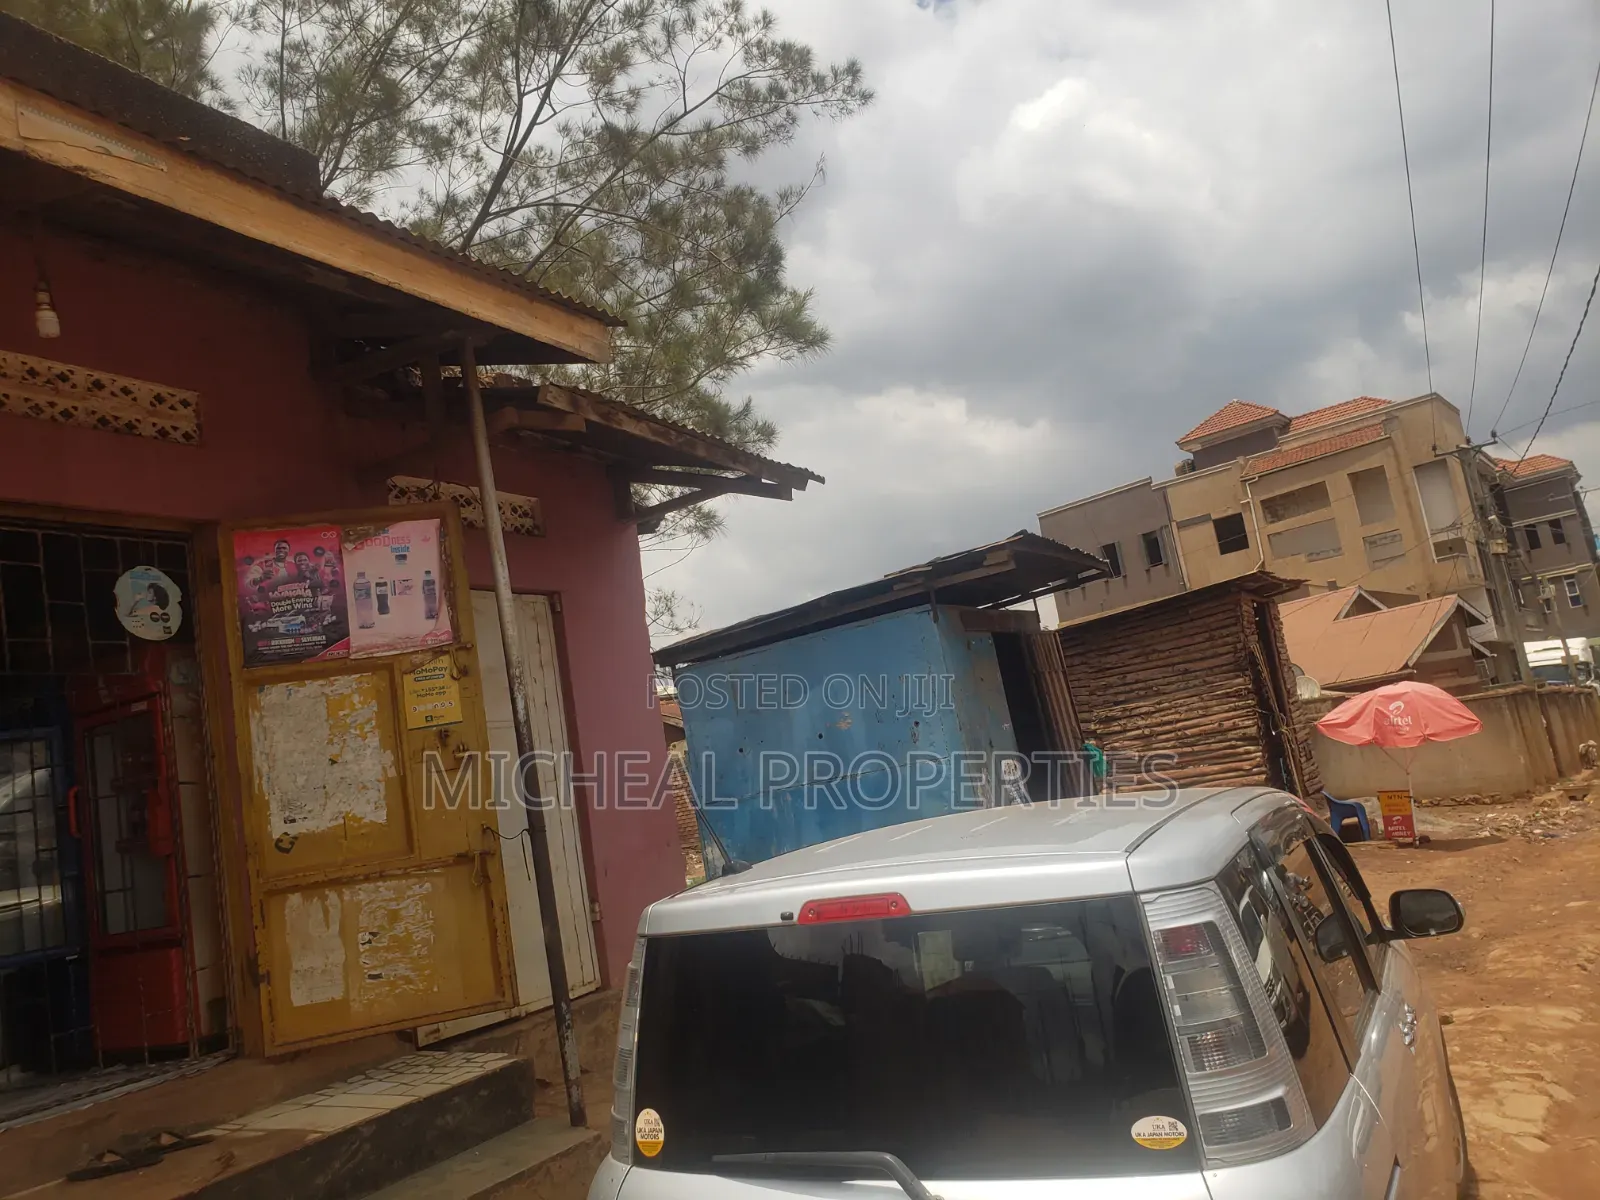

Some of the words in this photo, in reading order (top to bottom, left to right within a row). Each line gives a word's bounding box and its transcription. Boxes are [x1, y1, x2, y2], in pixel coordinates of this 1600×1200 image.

[271, 599, 291, 608] Double
[272, 605, 292, 614] More
[1383, 715, 1413, 726] airtel
